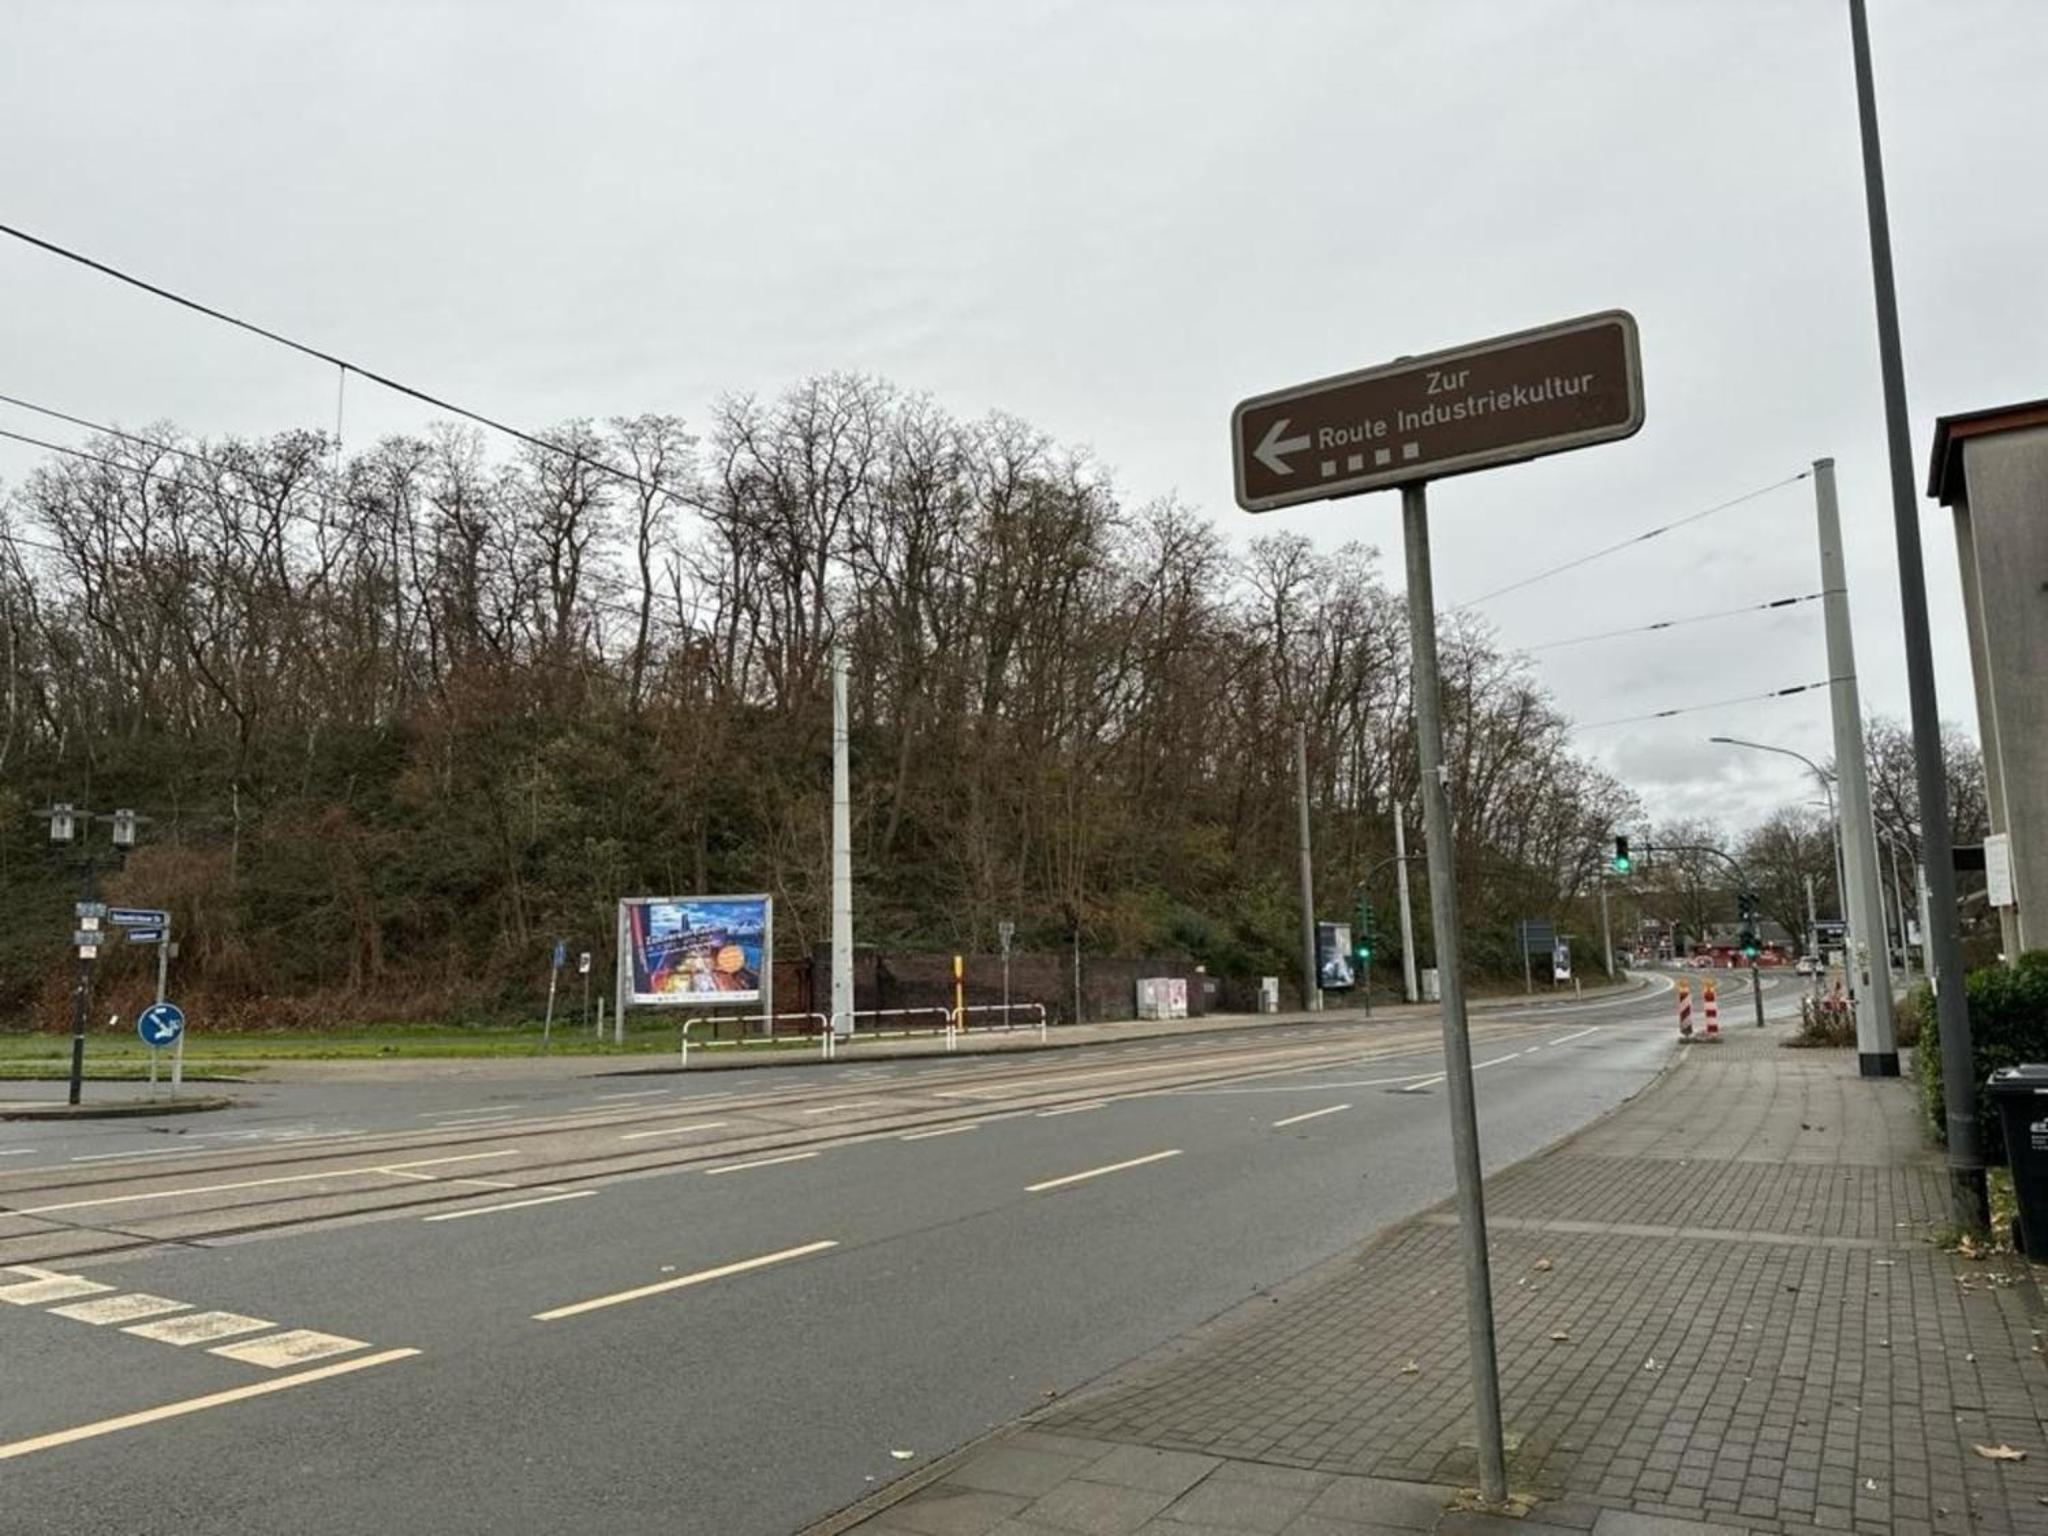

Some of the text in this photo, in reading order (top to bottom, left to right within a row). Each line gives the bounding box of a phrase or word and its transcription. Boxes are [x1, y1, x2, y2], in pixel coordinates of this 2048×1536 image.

[1427, 370, 1470, 395] Zur
[1318, 373, 1593, 449] Route Industriekultur
